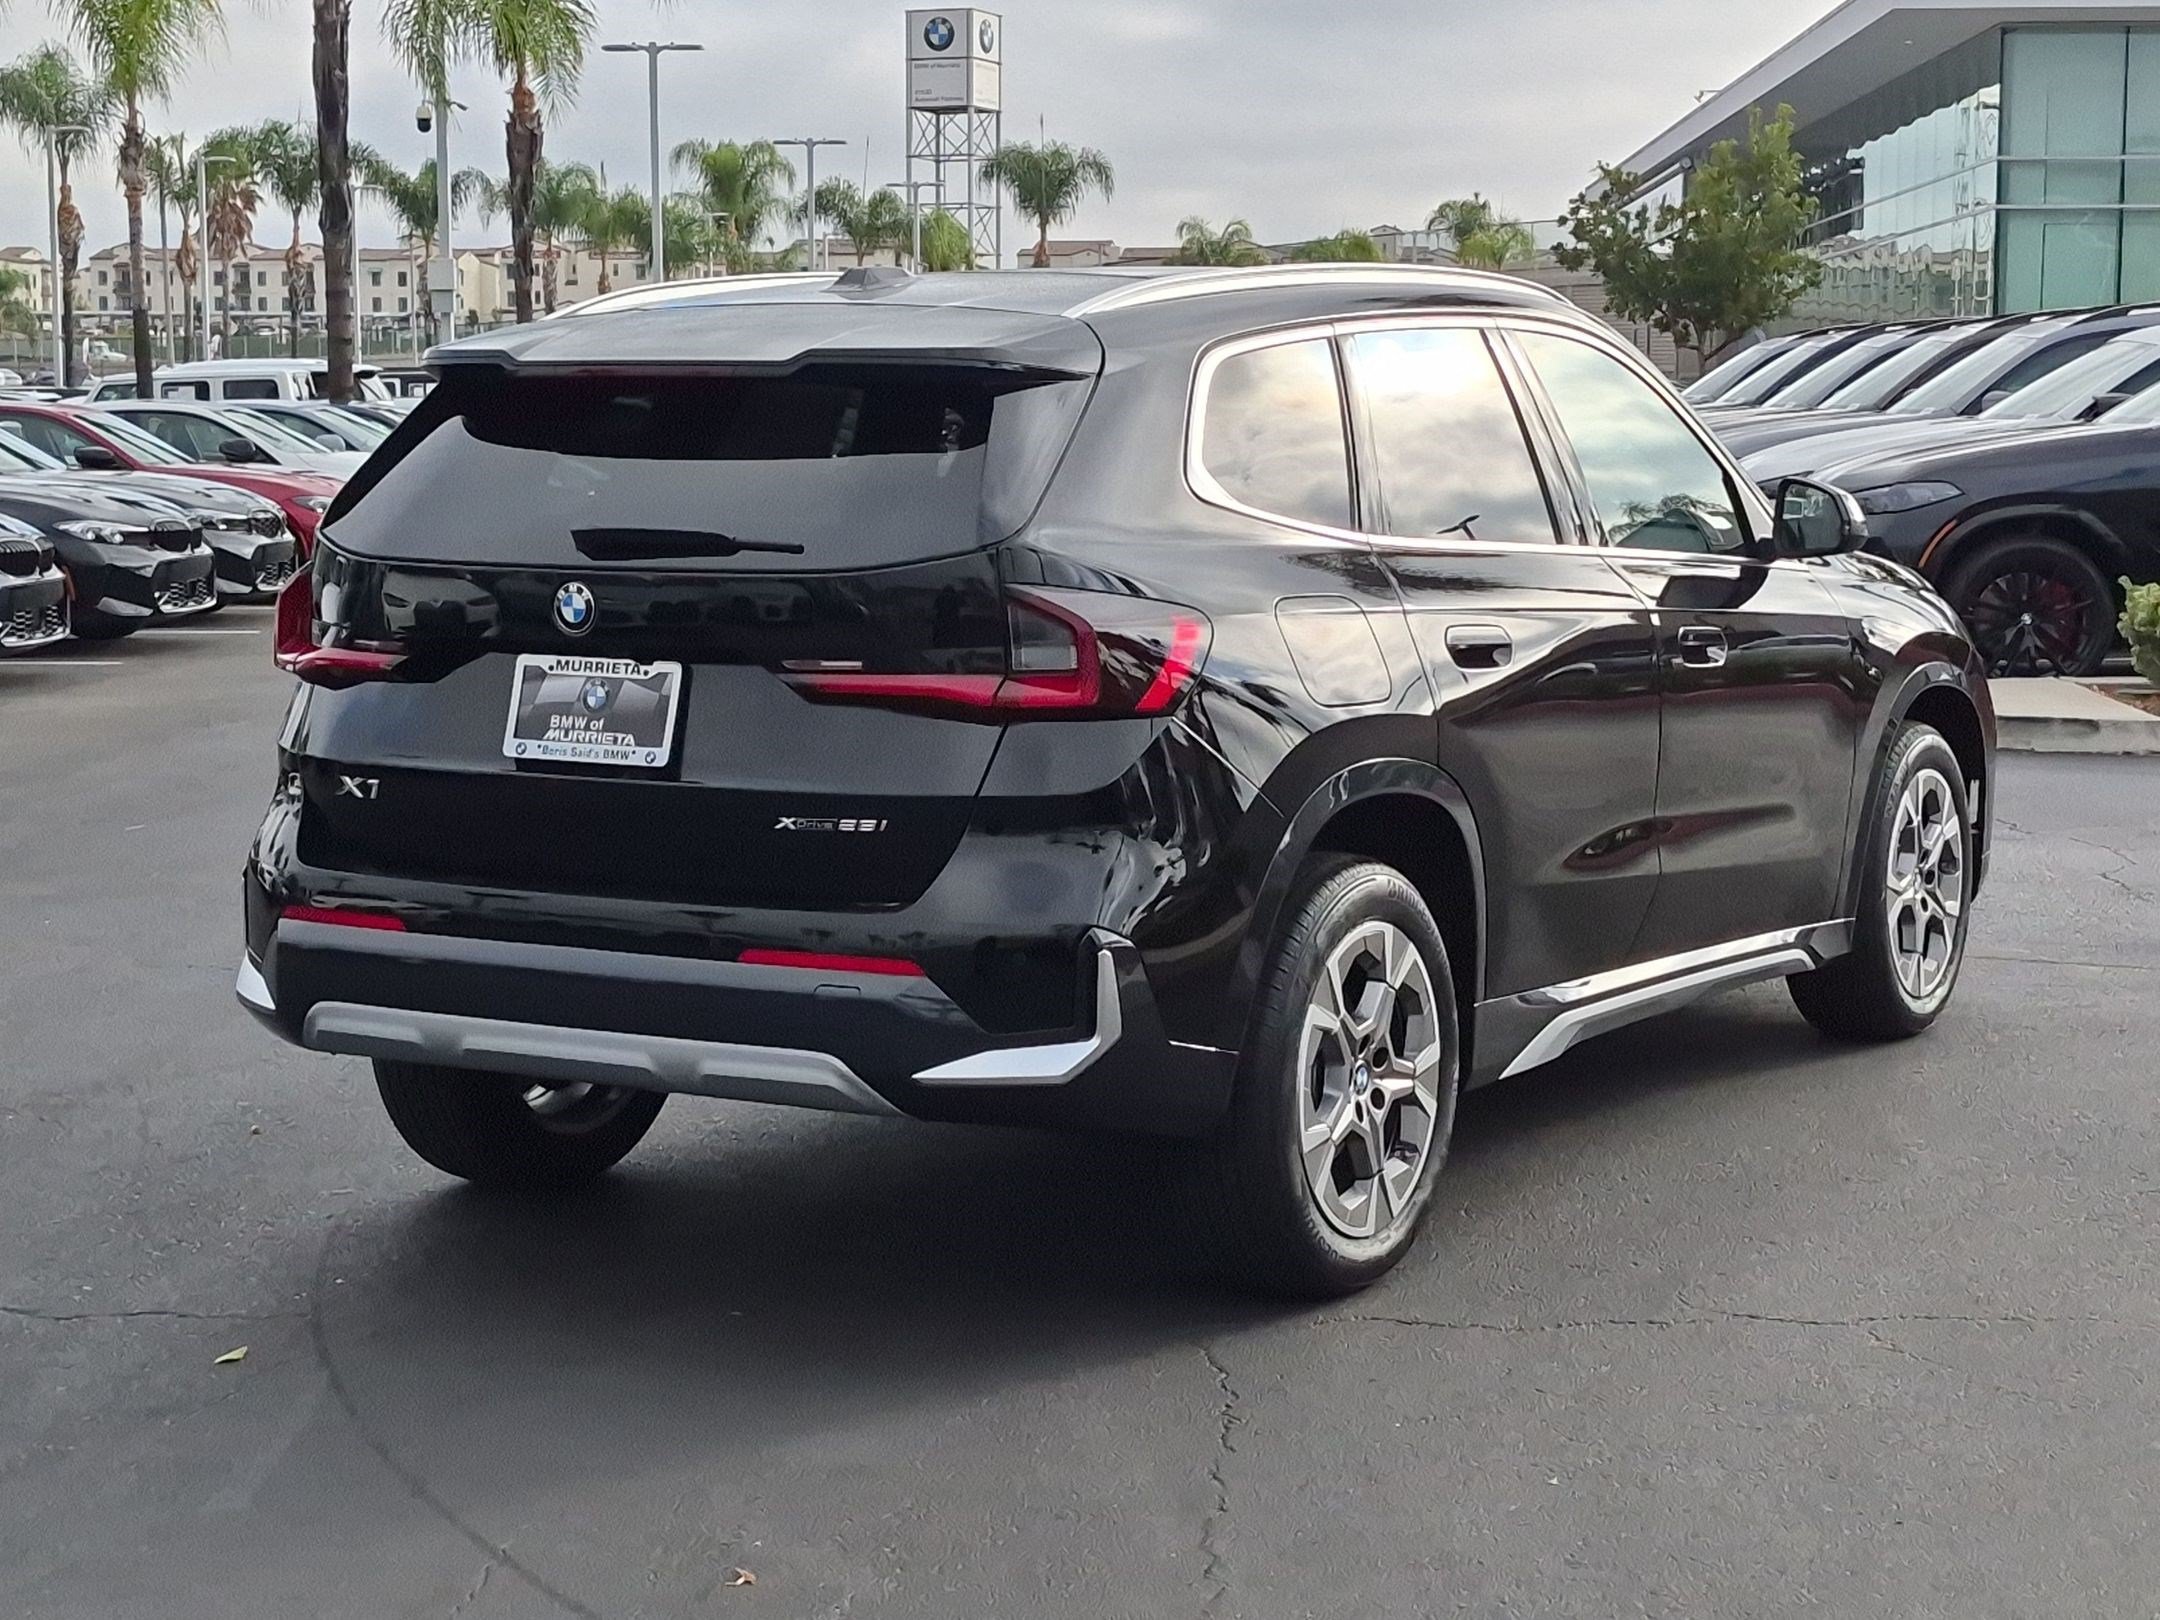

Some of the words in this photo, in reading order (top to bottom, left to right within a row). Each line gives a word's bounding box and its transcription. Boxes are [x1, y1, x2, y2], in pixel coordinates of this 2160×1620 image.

[555, 659, 641, 676] MURRIETA
[550, 714, 587, 728] BMW
[589, 717, 605, 730] of
[542, 729, 636, 746] MURRIETA
[336, 775, 380, 799] X1
